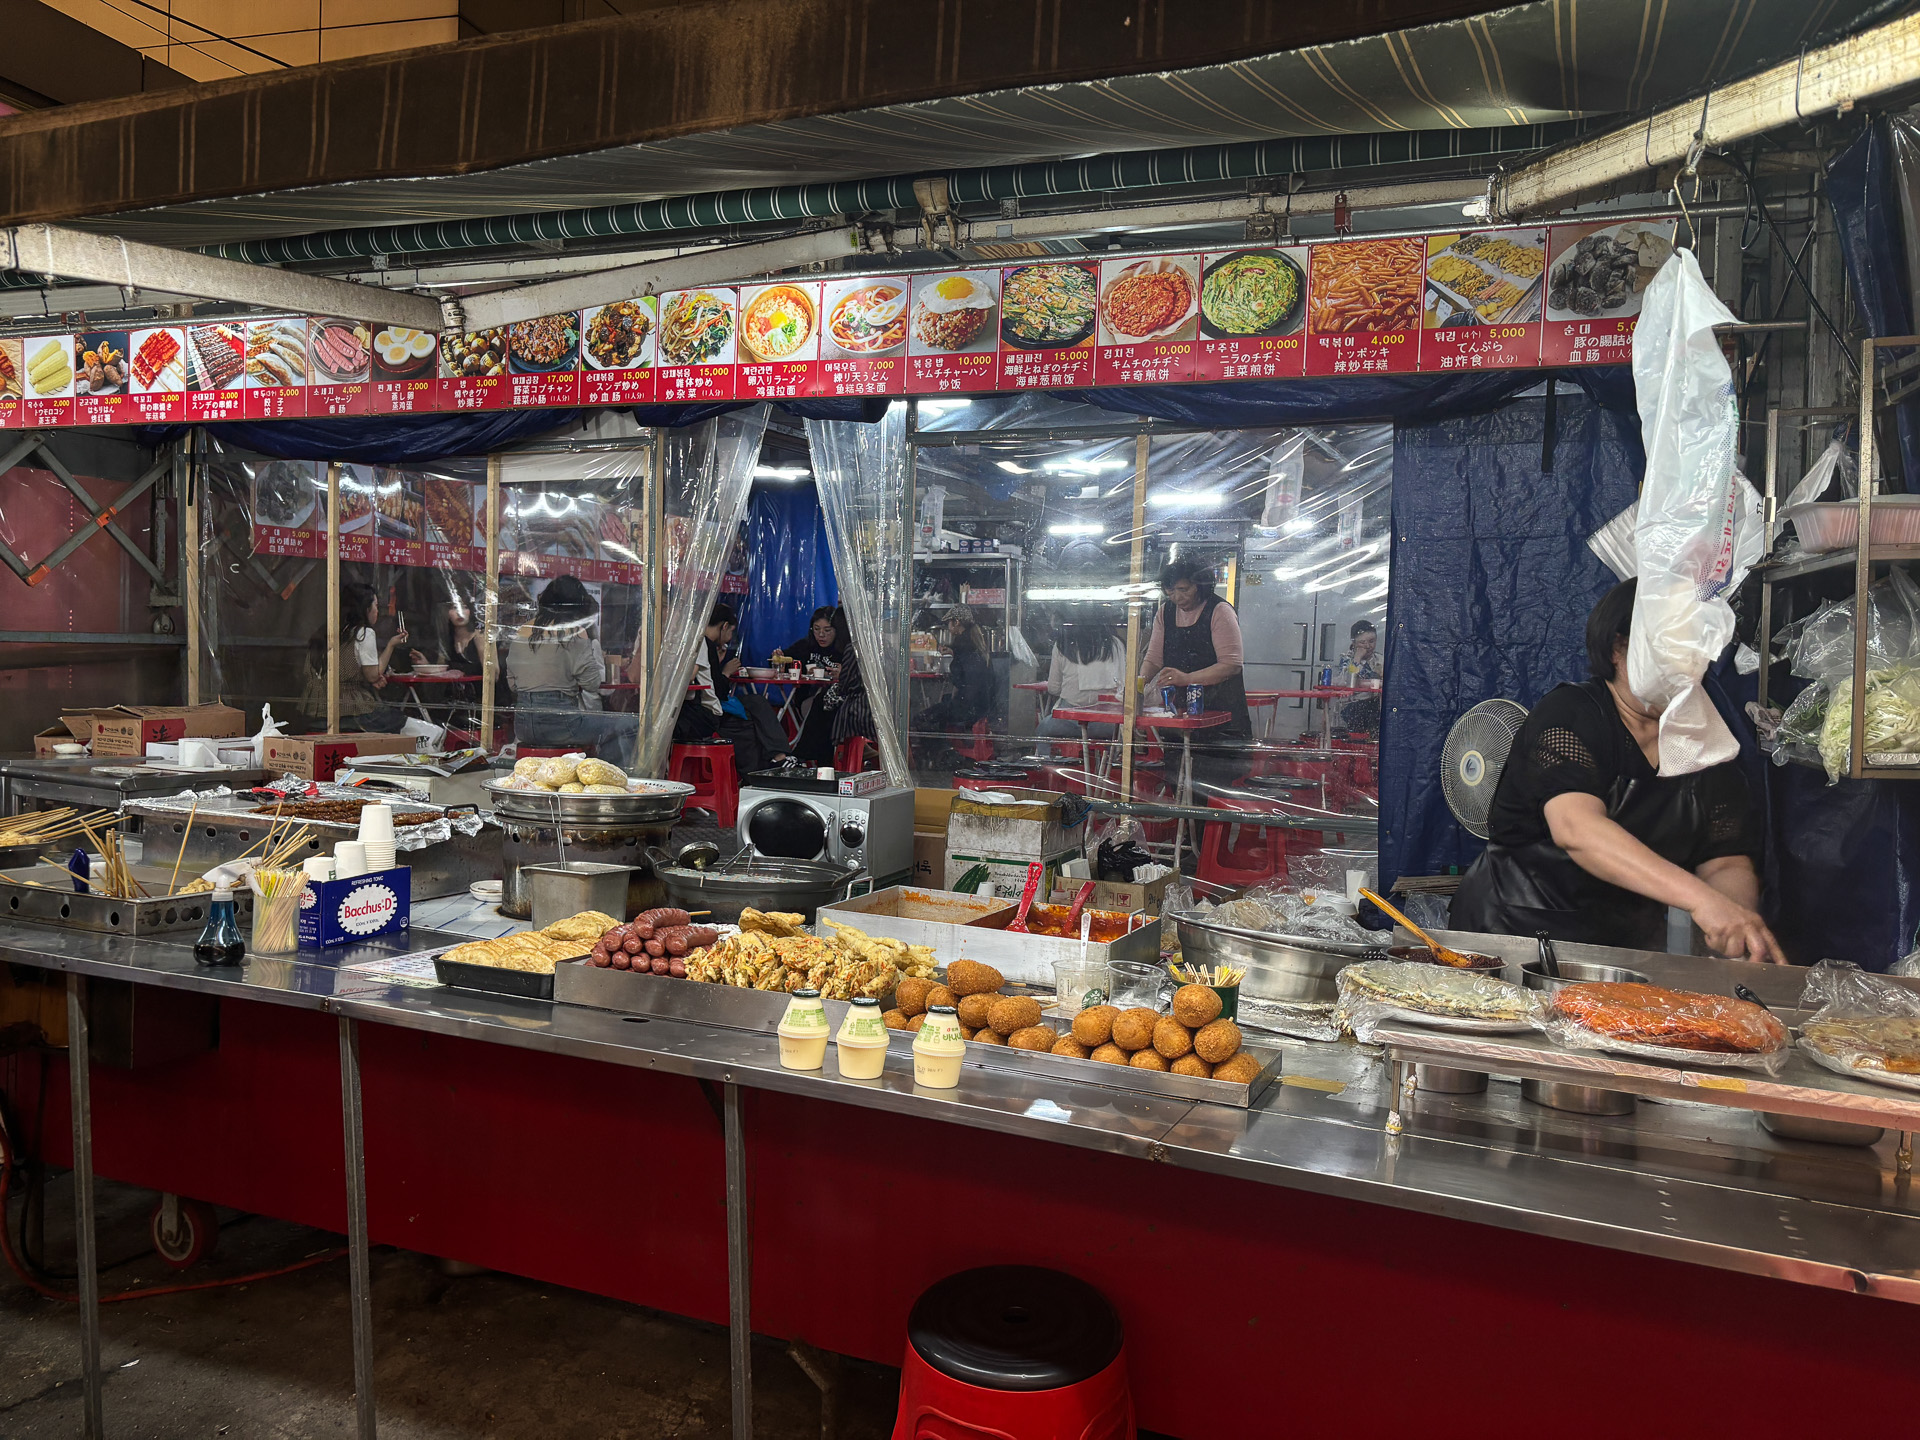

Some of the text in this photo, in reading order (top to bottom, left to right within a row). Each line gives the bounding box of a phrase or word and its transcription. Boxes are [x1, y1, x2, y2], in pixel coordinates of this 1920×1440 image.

[1617, 321, 1637, 332] 5,0
[1435, 331, 1456, 342] 튀김
[1489, 327, 1525, 339] 5,000
[1260, 339, 1298, 350] 10,000
[1319, 334, 1405, 348] 떡볶이 4,000
[1104, 345, 1191, 359] 김치전 10,000
[1457, 341, 1503, 353] てんぷら
[1006, 351, 1088, 364] 해물파전 15,000
[1220, 351, 1281, 364] ニラのチヂミ
[1338, 347, 1390, 359] トッポッキ
[825, 361, 894, 372] 어묵우동 7,000
[914, 356, 991, 369] 볶음밥 10,000
[1112, 356, 1180, 369] キムチのチヂミ
[1334, 359, 1388, 373] 辣炒年糕
[1440, 354, 1483, 368] 油炸食
[662, 368, 729, 378] 잡채볶음 15,000
[742, 364, 807, 375] 계란라면 7,000
[916, 367, 987, 379] キムチチャーハン
[547, 375, 574, 383] 17,000
[586, 371, 650, 382] 순대볶음 15,000
[1121, 369, 1169, 382] 辛奇煎饼
[476, 379, 497, 387] 3,000
[596, 381, 639, 391] スンデ炒め
[939, 378, 961, 390] 炒饭
[220, 392, 238, 400] 3,000
[280, 389, 299, 397] 5,000
[313, 386, 362, 395] 소세지 4,000
[104, 397, 122, 405] 3,000
[161, 394, 179, 402] 3,000
[324, 395, 352, 404] ソーセージ
[35, 408, 64, 416] トウモロコシ
